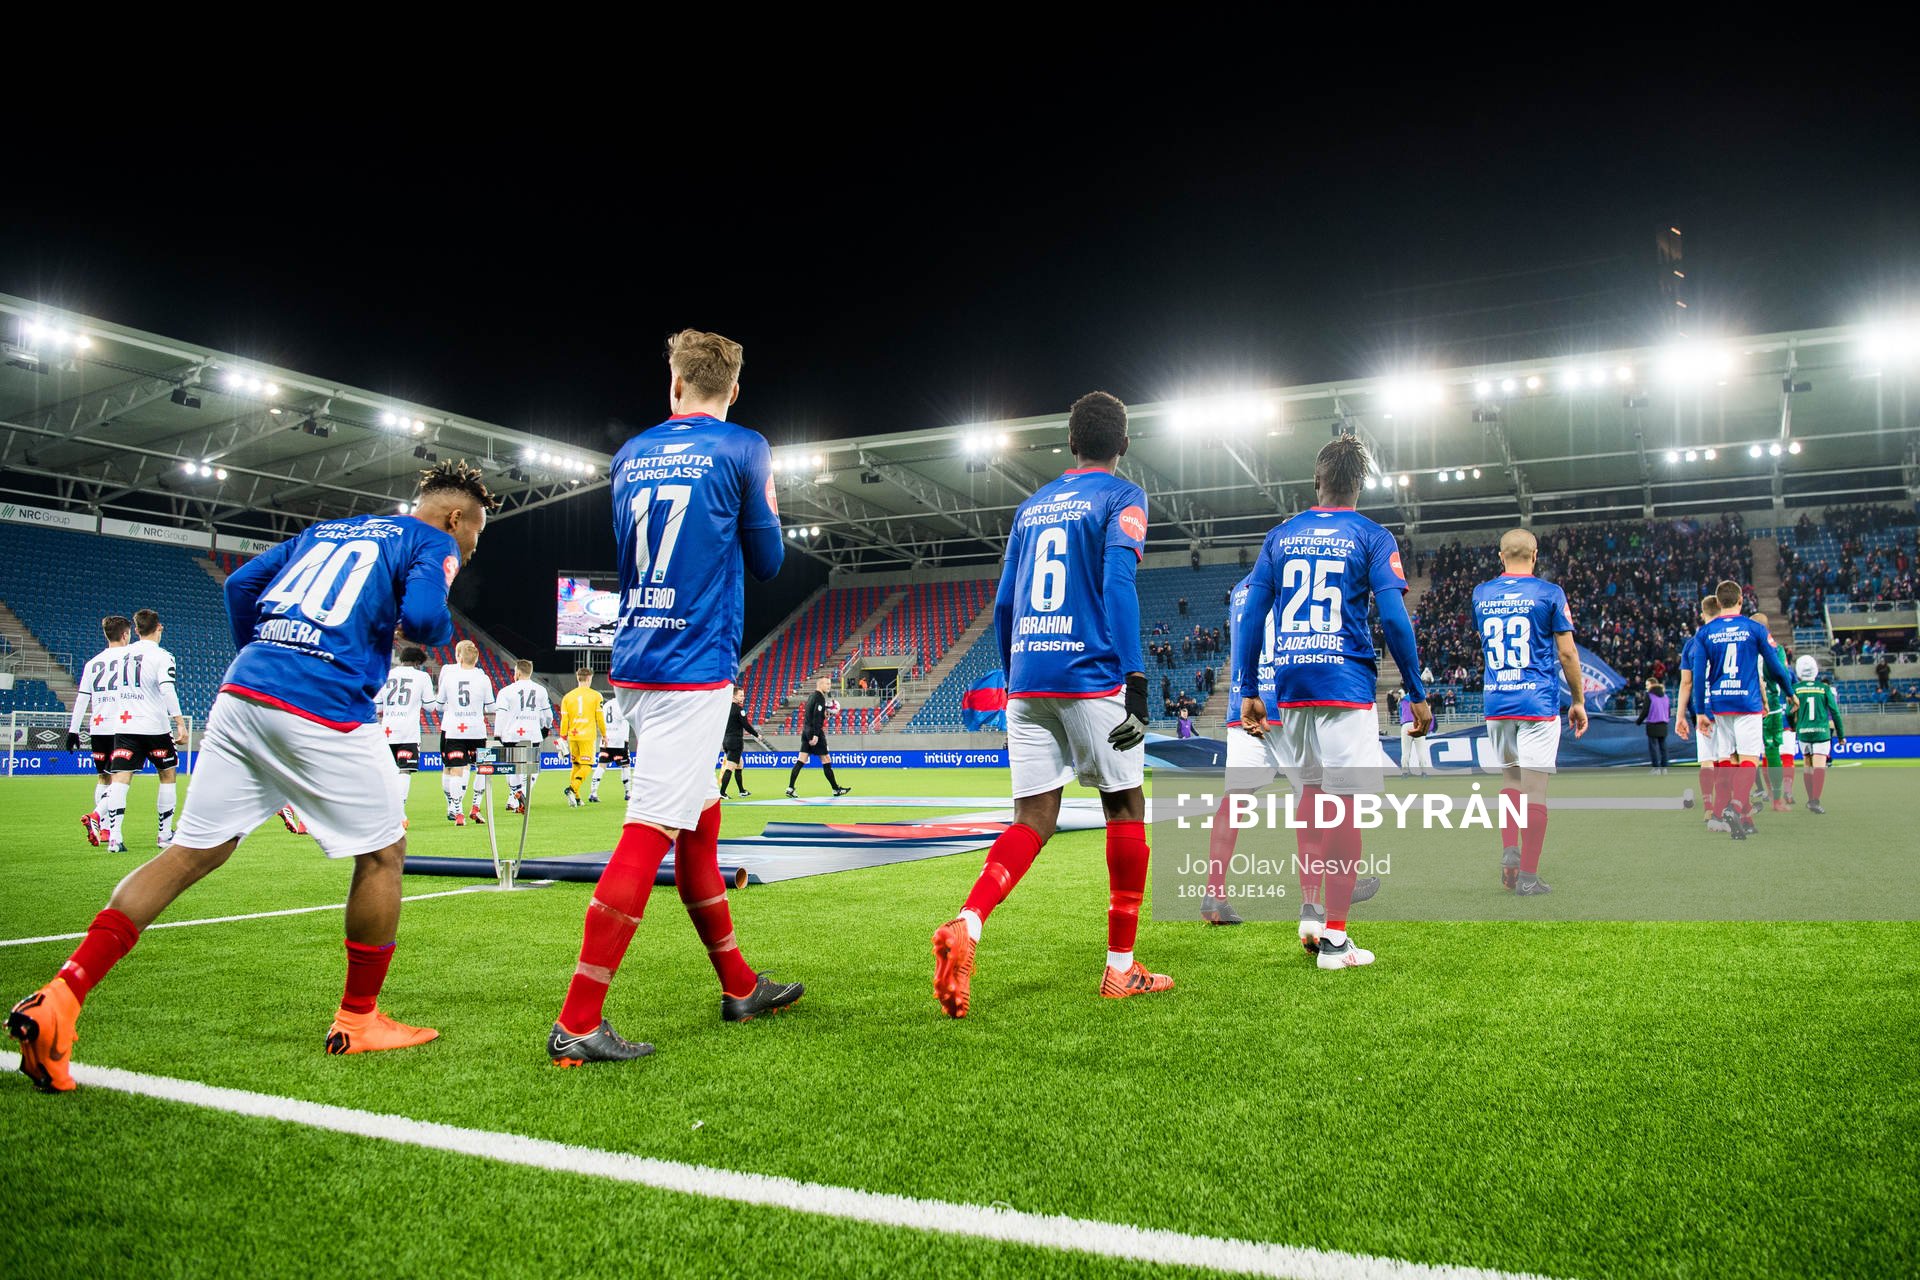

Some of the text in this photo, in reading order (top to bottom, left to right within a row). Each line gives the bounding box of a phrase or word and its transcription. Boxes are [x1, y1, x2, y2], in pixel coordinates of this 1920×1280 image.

[623, 454, 714, 472] HURTIGRUTA
[1022, 500, 1092, 518] HURTIGRUTA
[631, 485, 692, 584] 17
[1279, 537, 1356, 550] HURTIGRUTA
[1031, 527, 1067, 613] 6
[258, 540, 380, 627] 40
[1281, 558, 1345, 633] 25
[1478, 600, 1536, 608] HURTIGRUTA
[259, 618, 323, 646] CHIDERA
[633, 615, 687, 631] rasisme
[1019, 615, 1073, 635] IBRAHIM
[1028, 640, 1085, 652] rasisme
[1483, 616, 1531, 670] 33
[1293, 653, 1345, 665] rasisme
[1723, 642, 1739, 679] 4
[91, 661, 119, 692] 22
[1498, 682, 1537, 691] rasisme
[385, 677, 414, 706] 25
[458, 681, 470, 707] 5
[517, 689, 537, 711] 14
[1806, 696, 1815, 721] 1
[1833, 741, 1886, 753] arena
[870, 755, 902, 764] arena
[965, 754, 999, 764] arena
